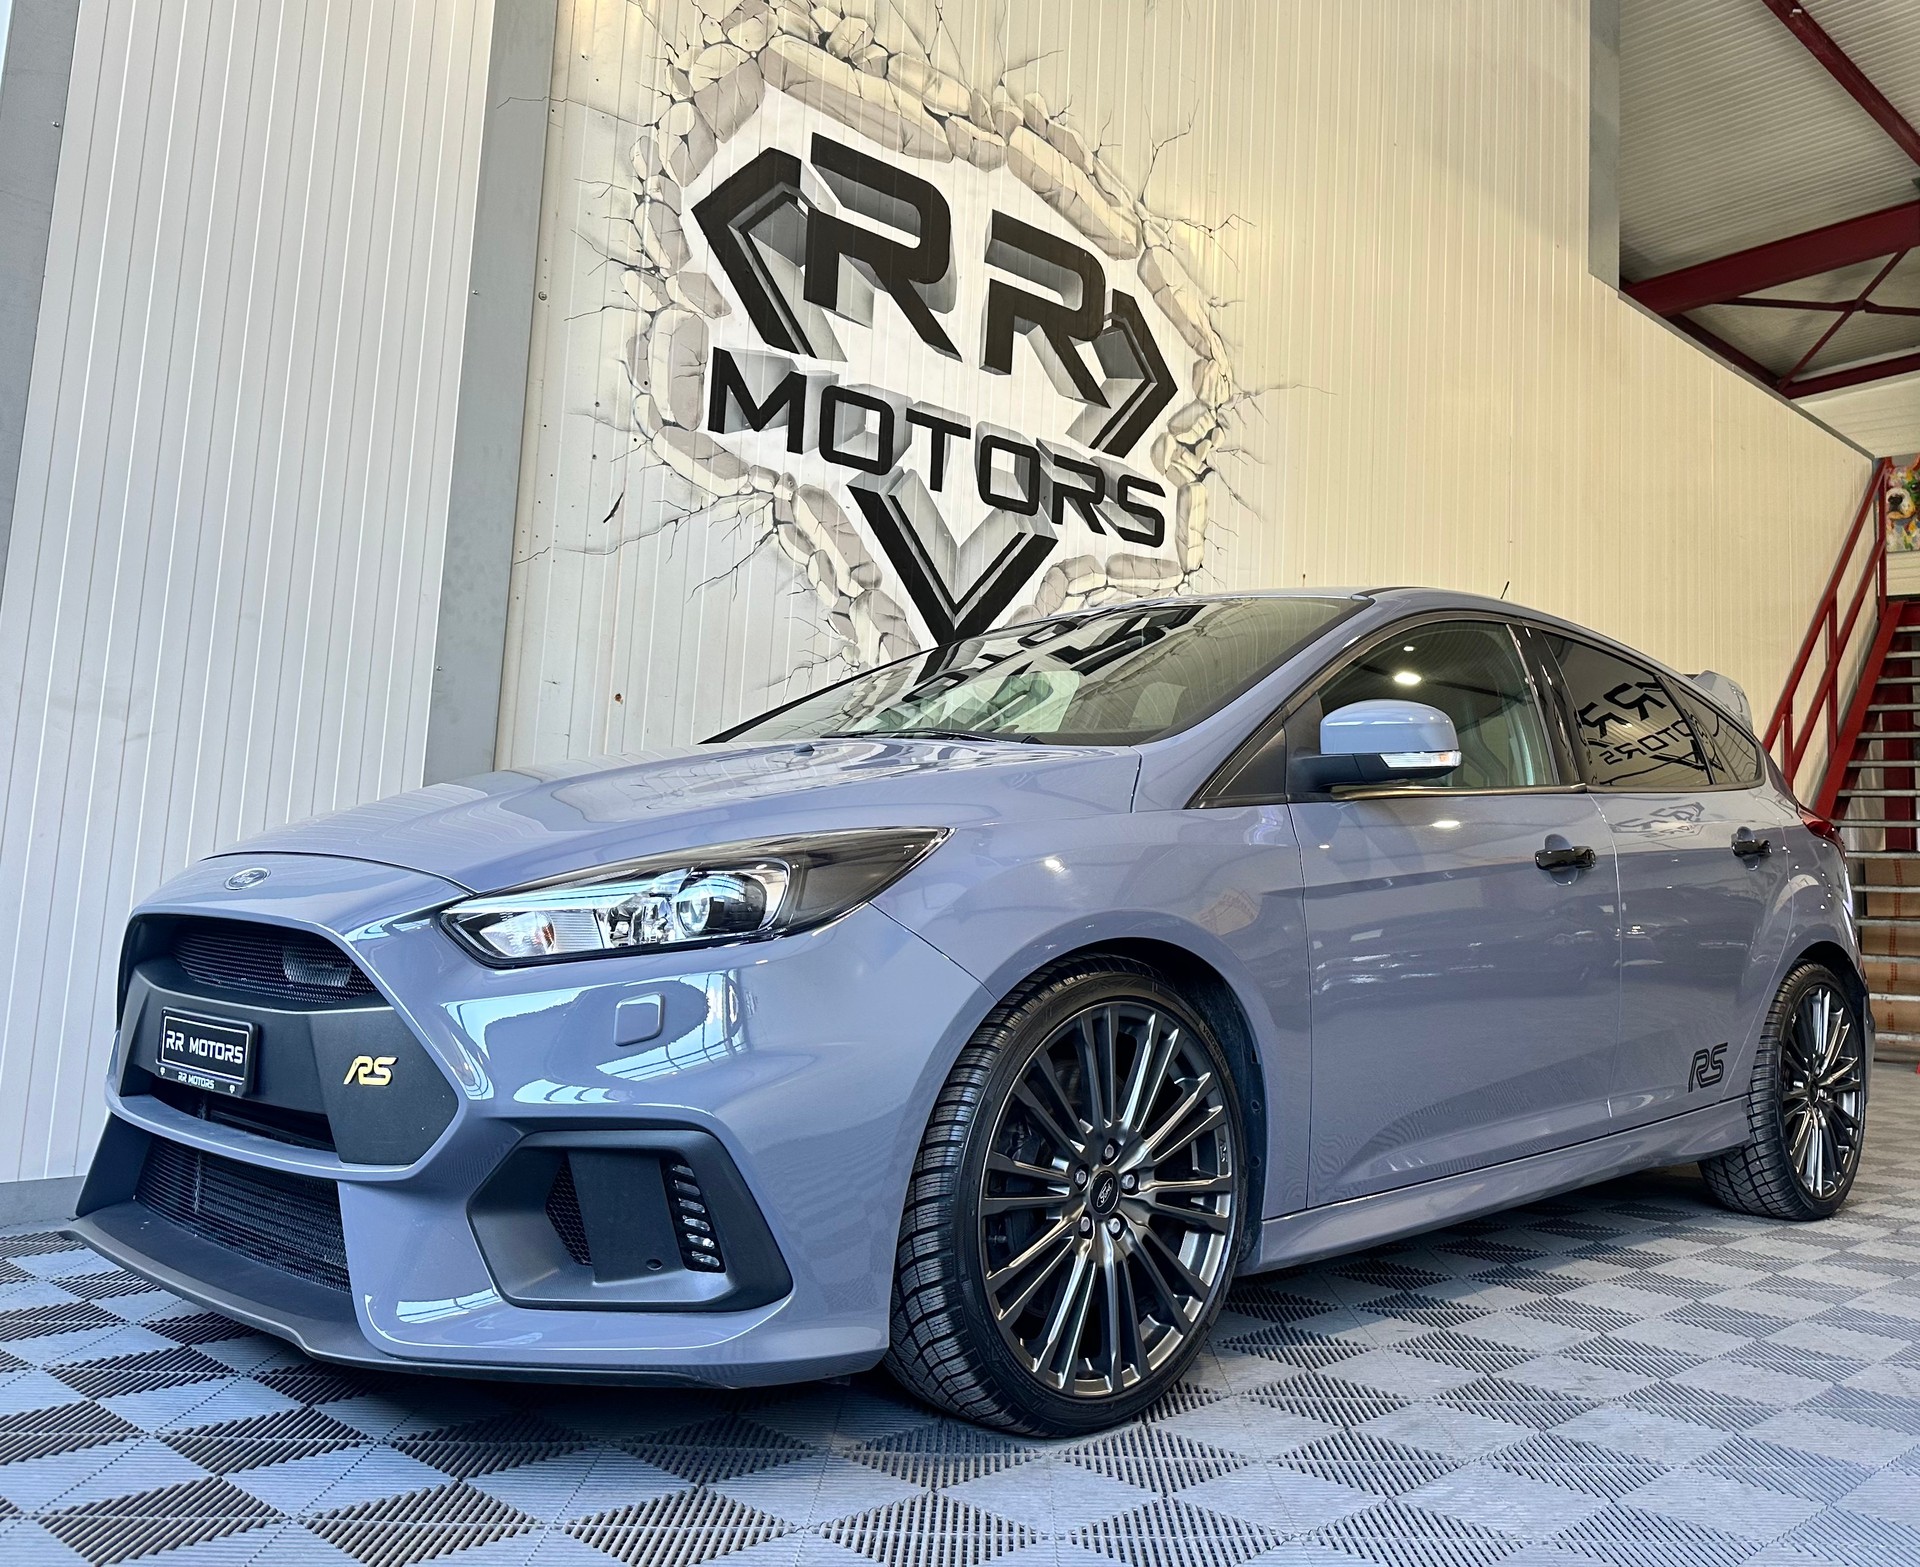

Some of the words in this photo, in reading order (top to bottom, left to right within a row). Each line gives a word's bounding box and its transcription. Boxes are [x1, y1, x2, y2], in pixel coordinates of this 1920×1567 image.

[707, 346, 1167, 548] MOTORS
[165, 1030, 184, 1052] RR
[189, 1036, 243, 1064] MOTORS
[177, 1071, 187, 1083] RR
[188, 1074, 215, 1089] MOTORS
[343, 1055, 397, 1086] RS
[1687, 1042, 1729, 1093] RS
